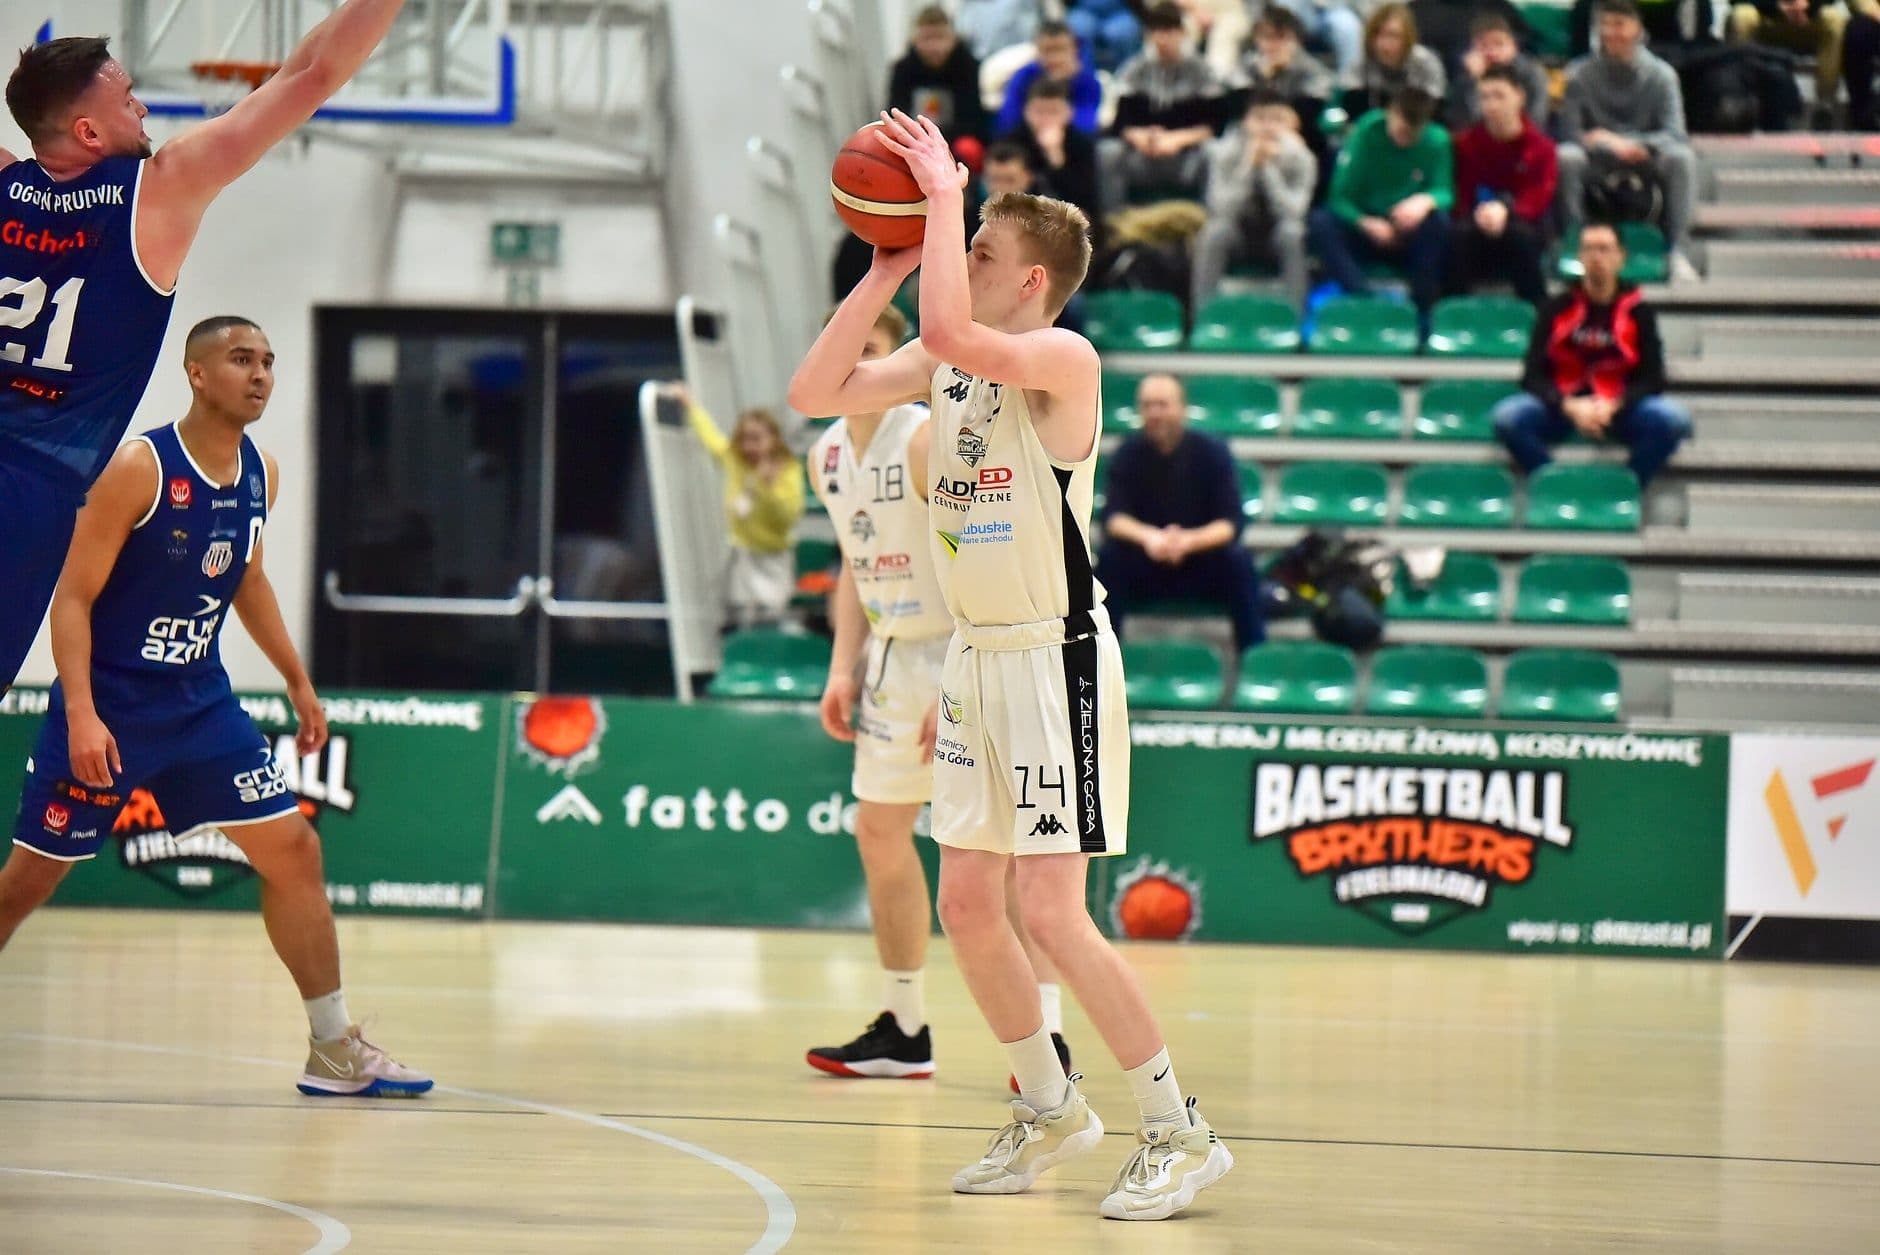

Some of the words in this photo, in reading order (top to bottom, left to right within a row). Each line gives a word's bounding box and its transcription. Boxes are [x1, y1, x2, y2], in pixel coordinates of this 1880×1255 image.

[8, 181, 52, 212] OGOŃ
[0, 276, 85, 372] 21
[869, 463, 905, 504] 18
[961, 521, 1013, 535] ubuskie
[947, 752, 975, 767] Góra
[1080, 697, 1094, 779] ZIELONA
[623, 785, 790, 833] fatto
[1014, 765, 1067, 809] 14
[1253, 762, 1572, 848] BASKETBALL
